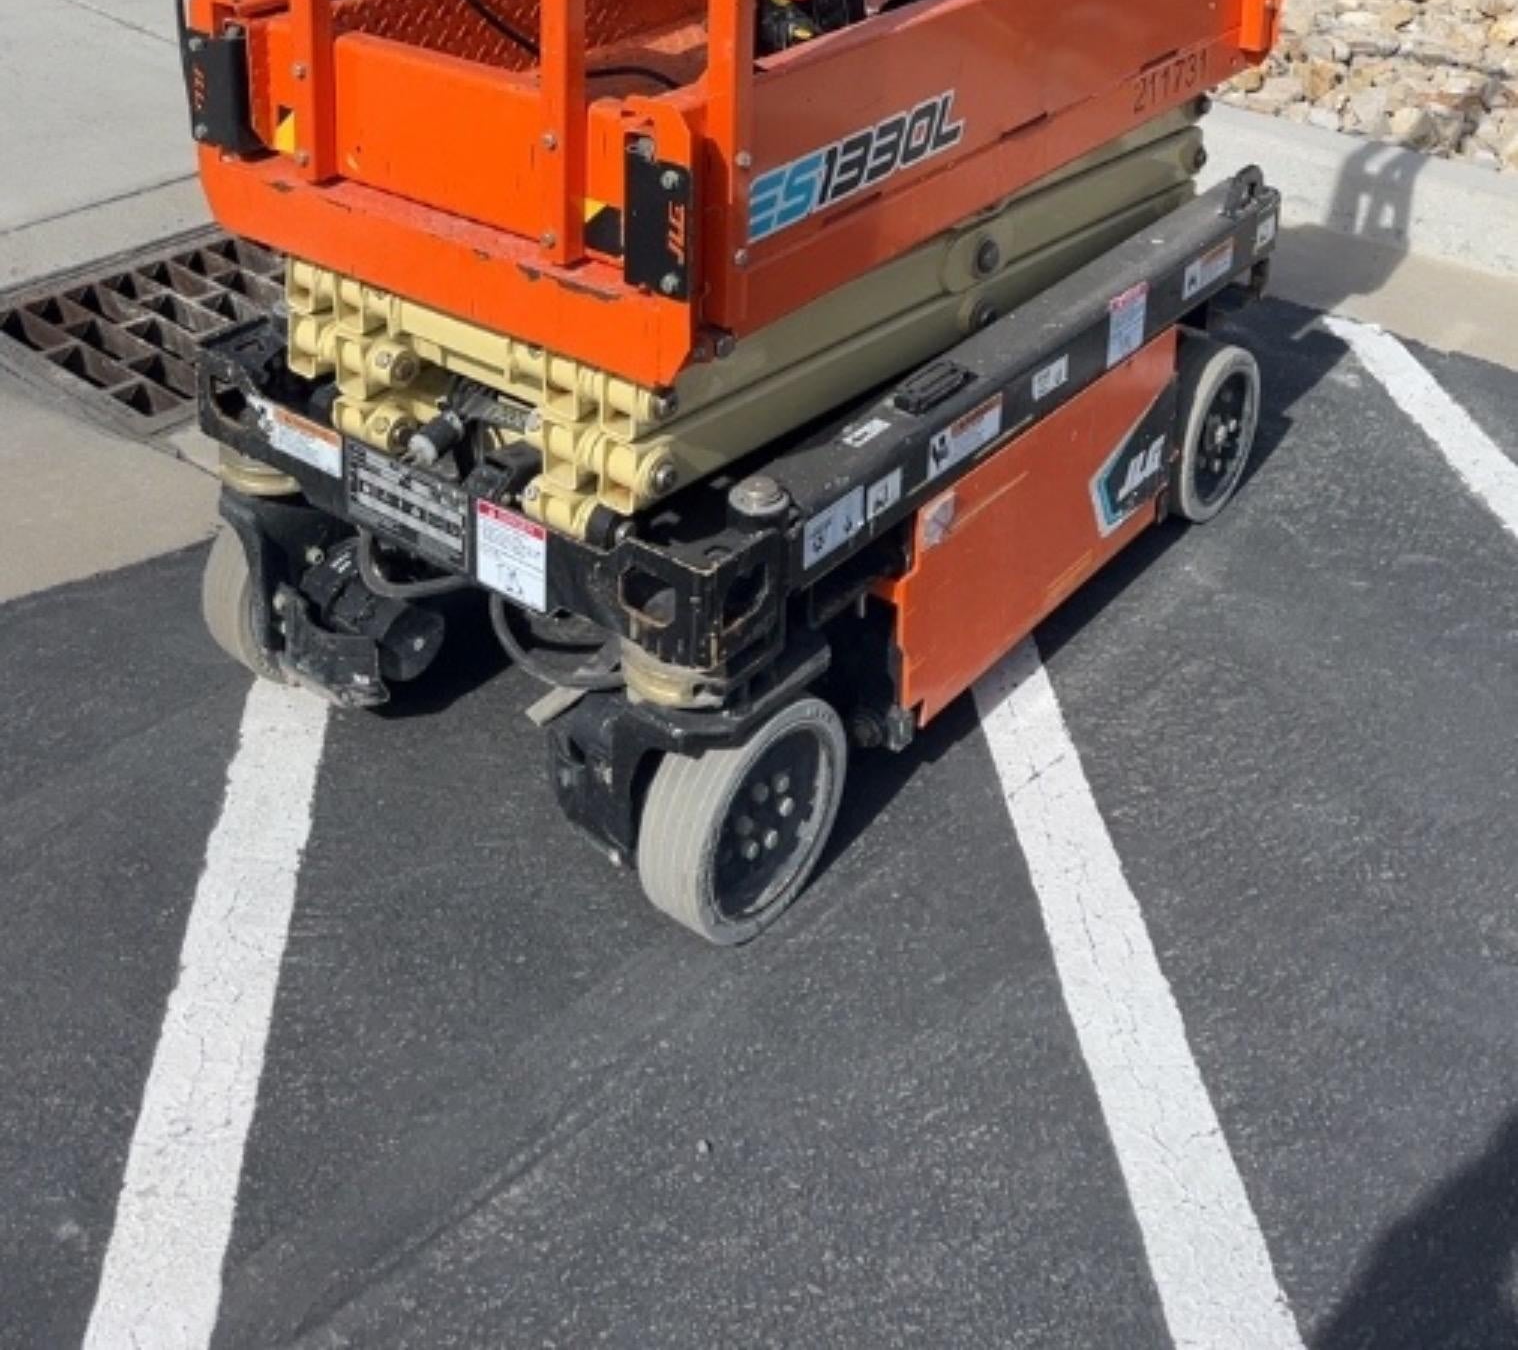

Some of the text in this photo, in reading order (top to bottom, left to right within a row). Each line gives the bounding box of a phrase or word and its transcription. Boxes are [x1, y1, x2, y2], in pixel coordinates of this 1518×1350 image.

[1133, 48, 1208, 115] 211731
[748, 90, 966, 242] ES1330L
[667, 200, 686, 266] JLG
[1116, 433, 1166, 502] JLG
